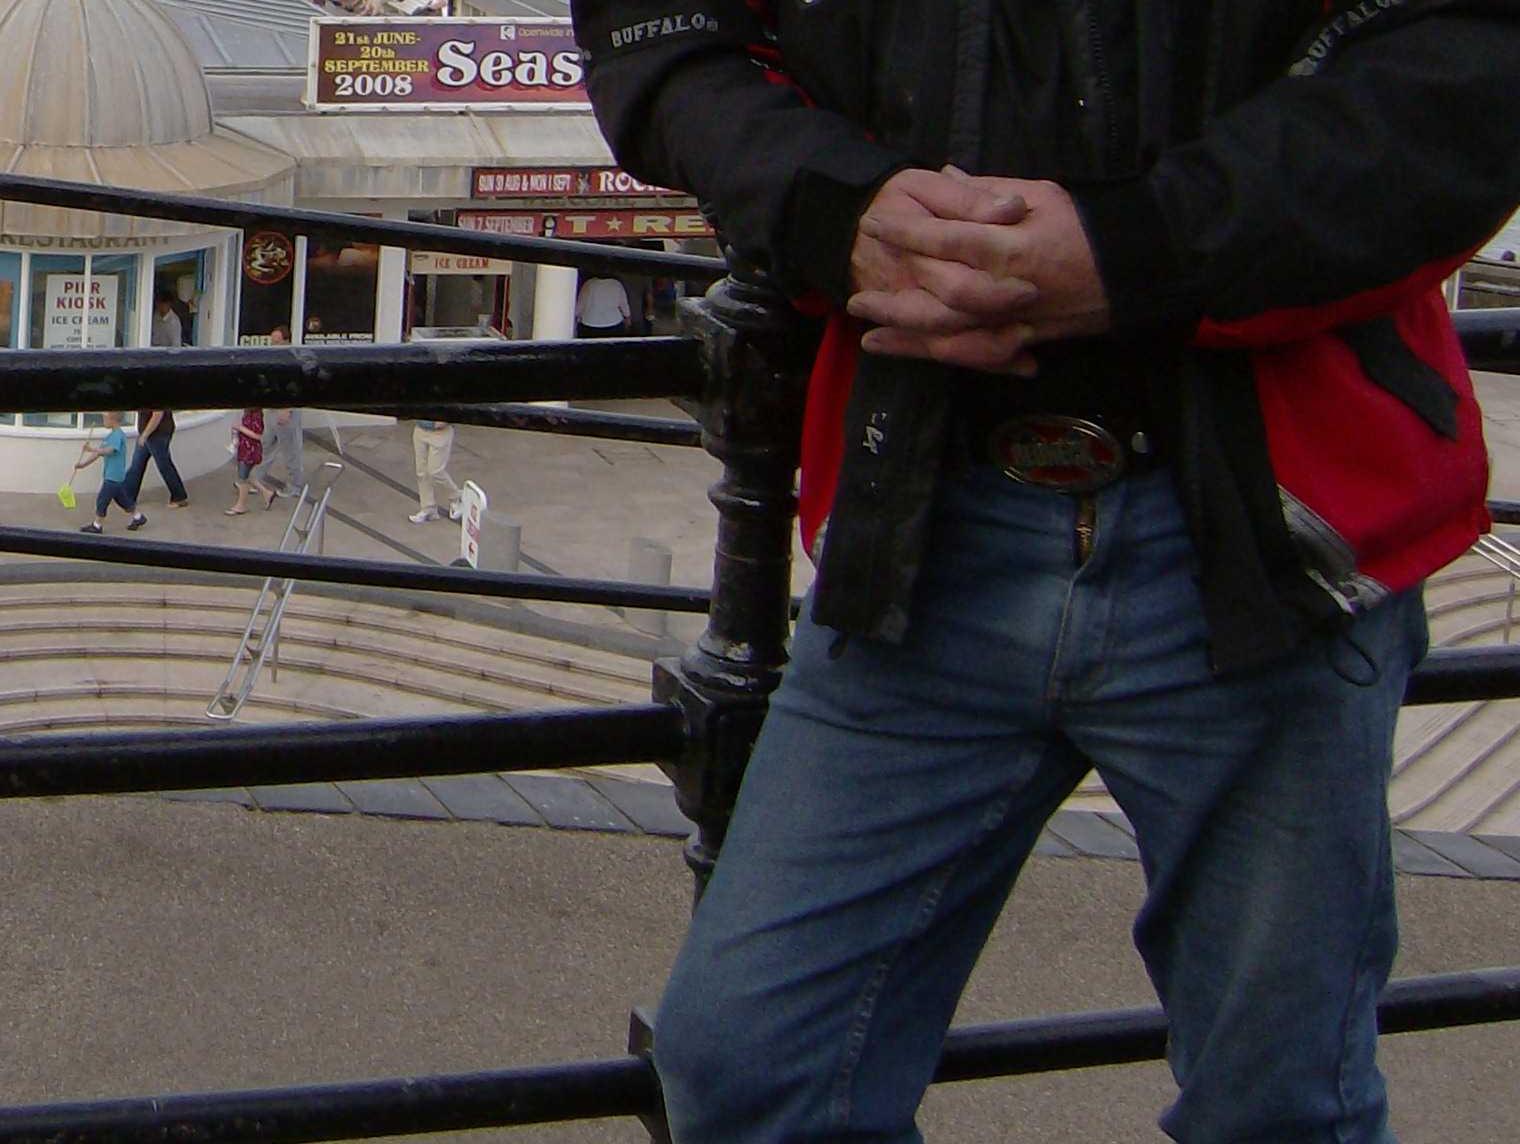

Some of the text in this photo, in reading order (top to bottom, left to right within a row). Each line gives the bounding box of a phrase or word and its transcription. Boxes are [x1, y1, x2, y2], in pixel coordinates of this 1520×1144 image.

[611, 12, 706, 48] BUFFALO
[360, 46, 395, 59] 20th
[324, 59, 429, 73] SEPTEMBER
[334, 74, 414, 97] 2008
[478, 174, 494, 192] SUN
[565, 216, 596, 233] T
[435, 257, 489, 270] ICE CREAM
[52, 315, 68, 325] ICE
